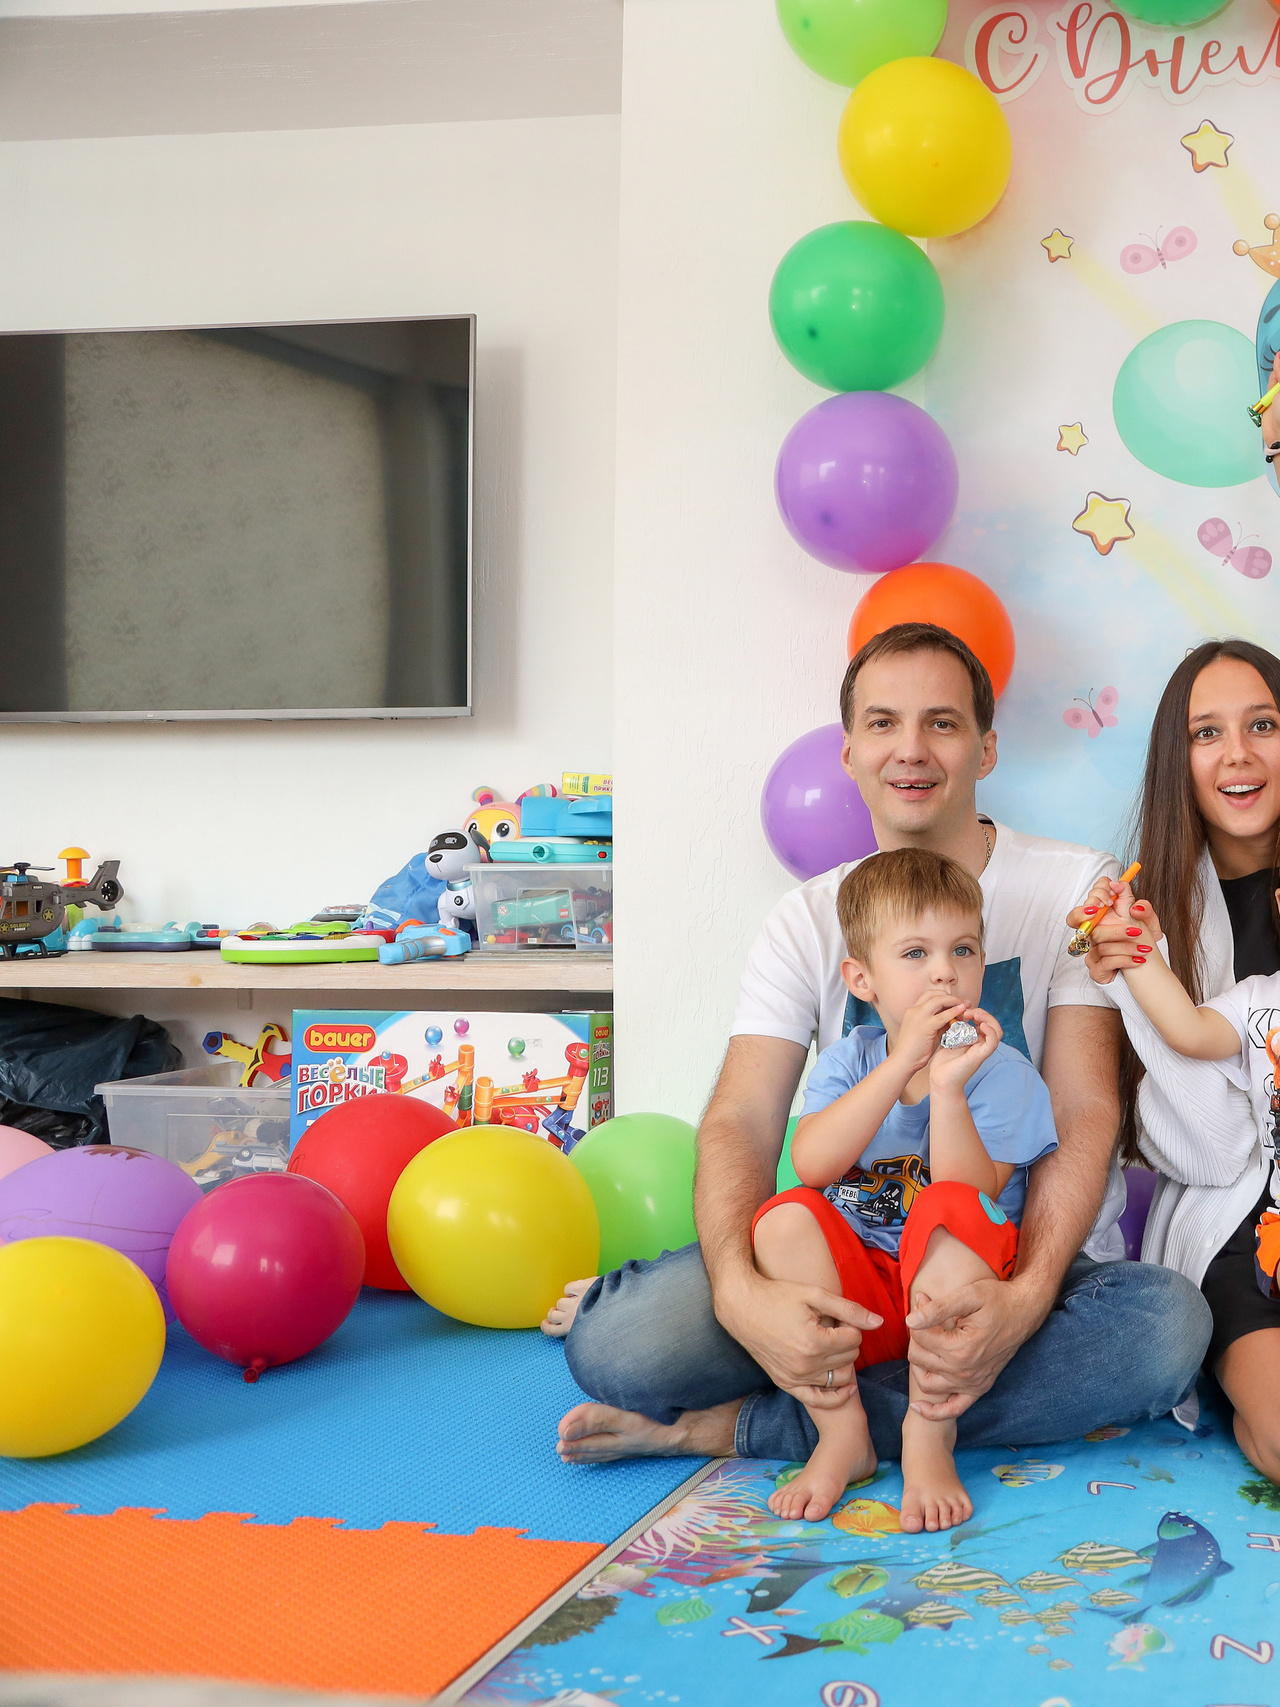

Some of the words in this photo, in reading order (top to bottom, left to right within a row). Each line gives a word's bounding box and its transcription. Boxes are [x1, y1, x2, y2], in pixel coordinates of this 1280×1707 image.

[975, 12, 1038, 94] С
[310, 1030, 372, 1047] bauer
[593, 1067, 609, 1087] 113
[1087, 1480, 1138, 1496] L
[720, 1616, 787, 1646] X
